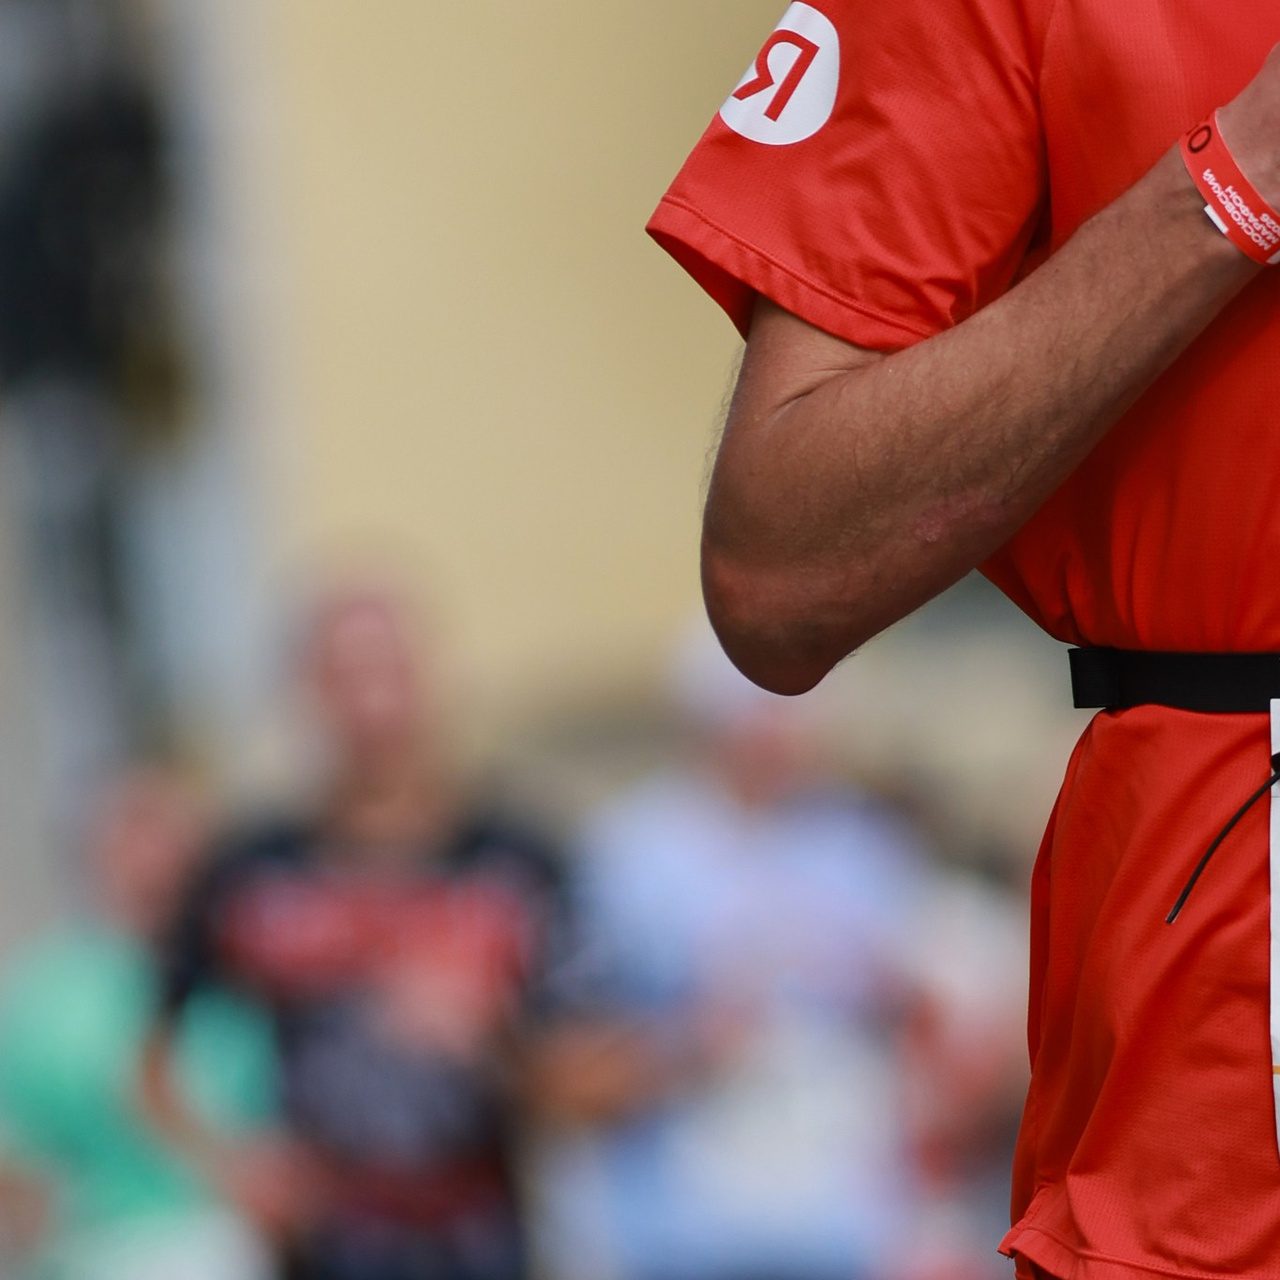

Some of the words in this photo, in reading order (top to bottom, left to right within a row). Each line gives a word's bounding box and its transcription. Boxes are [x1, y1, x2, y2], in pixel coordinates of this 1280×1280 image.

[731, 29, 821, 122] Я
[1202, 168, 1272, 251] МОСКОВСКИЙ
[1225, 185, 1280, 244] МАРАФОН
